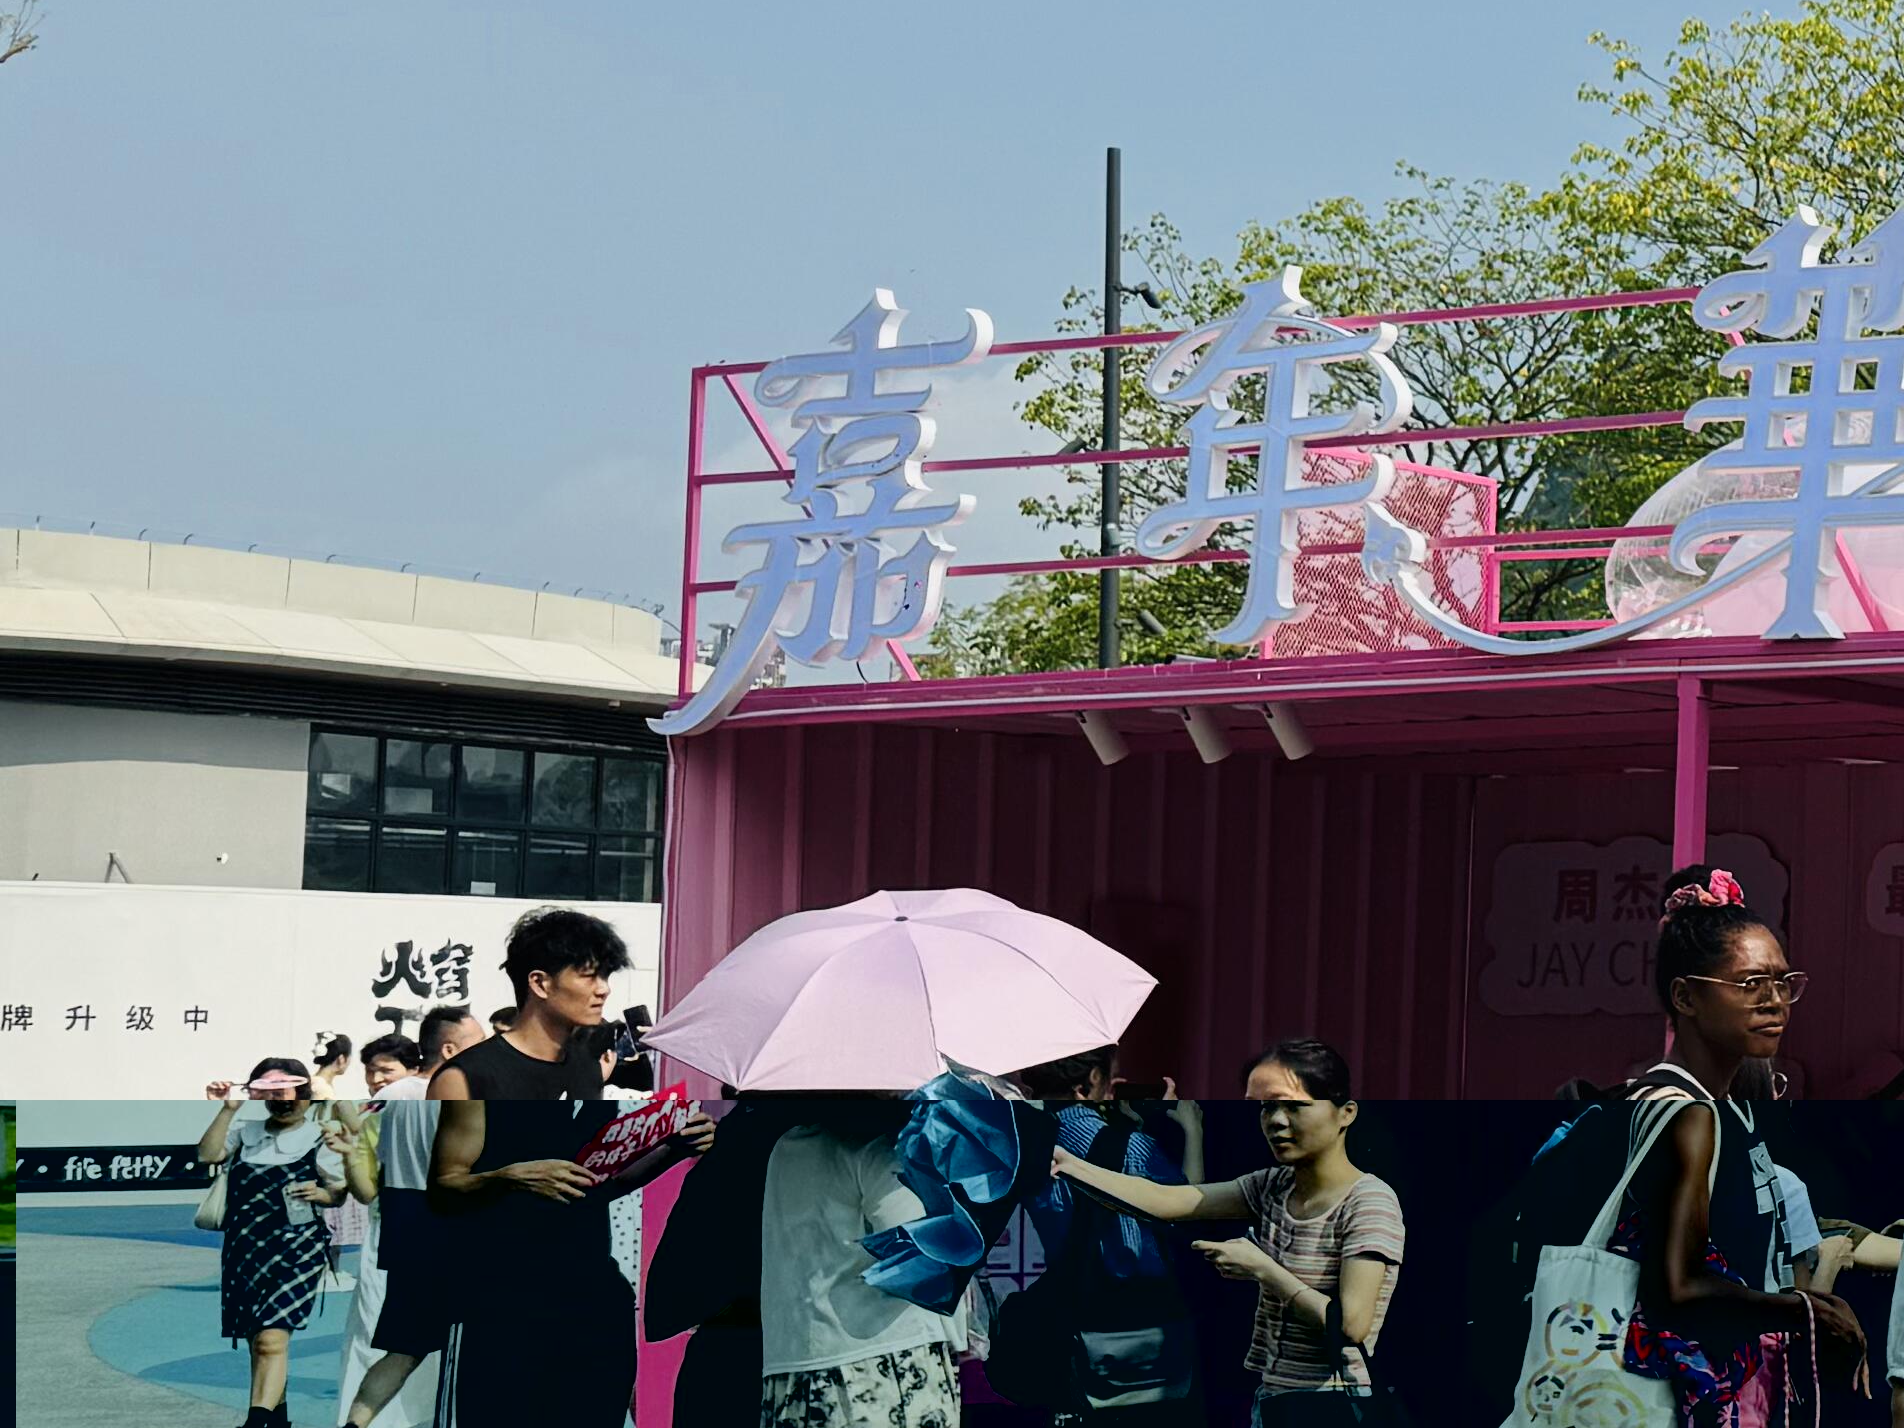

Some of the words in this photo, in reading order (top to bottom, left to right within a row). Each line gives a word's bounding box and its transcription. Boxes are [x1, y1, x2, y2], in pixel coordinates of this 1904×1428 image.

[1517, 941, 1595, 988] JAY
[1, 1004, 209, 1032] 牌升级中
